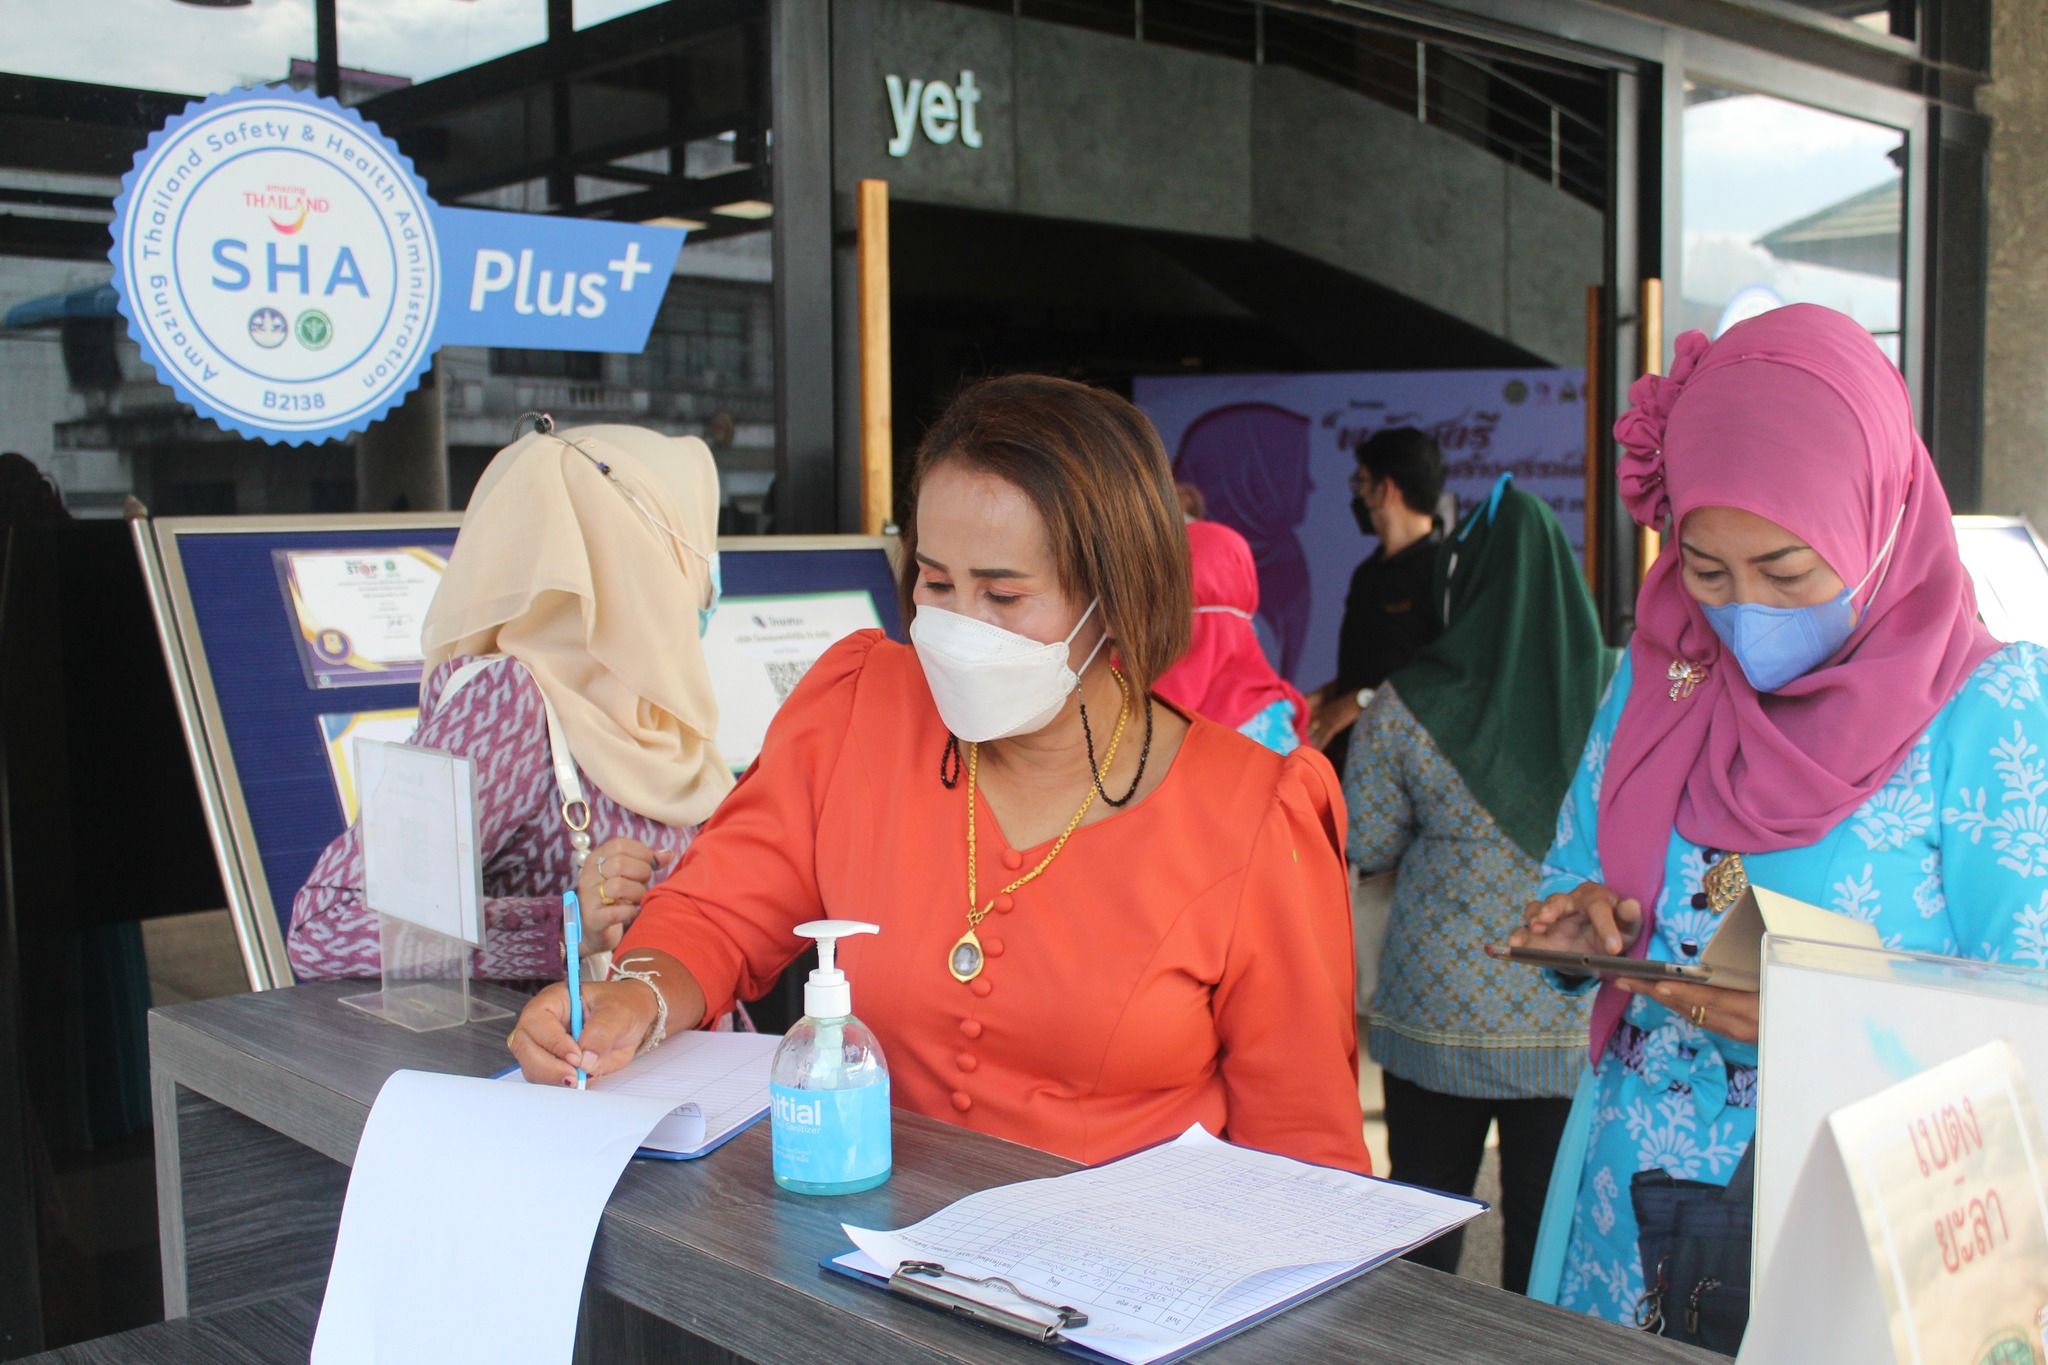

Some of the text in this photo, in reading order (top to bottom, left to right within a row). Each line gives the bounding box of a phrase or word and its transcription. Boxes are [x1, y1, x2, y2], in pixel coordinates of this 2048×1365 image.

[885, 70, 983, 157] yet
[242, 192, 330, 213] THAILAND
[265, 184, 306, 196] amazing
[143, 120, 426, 390] Amazing Thailand Safety & Health Administration
[211, 238, 370, 298] SHA
[262, 390, 326, 412] B2138
[1907, 1095, 1983, 1179] เบตง
[1934, 1188, 2010, 1275] ยะลา
